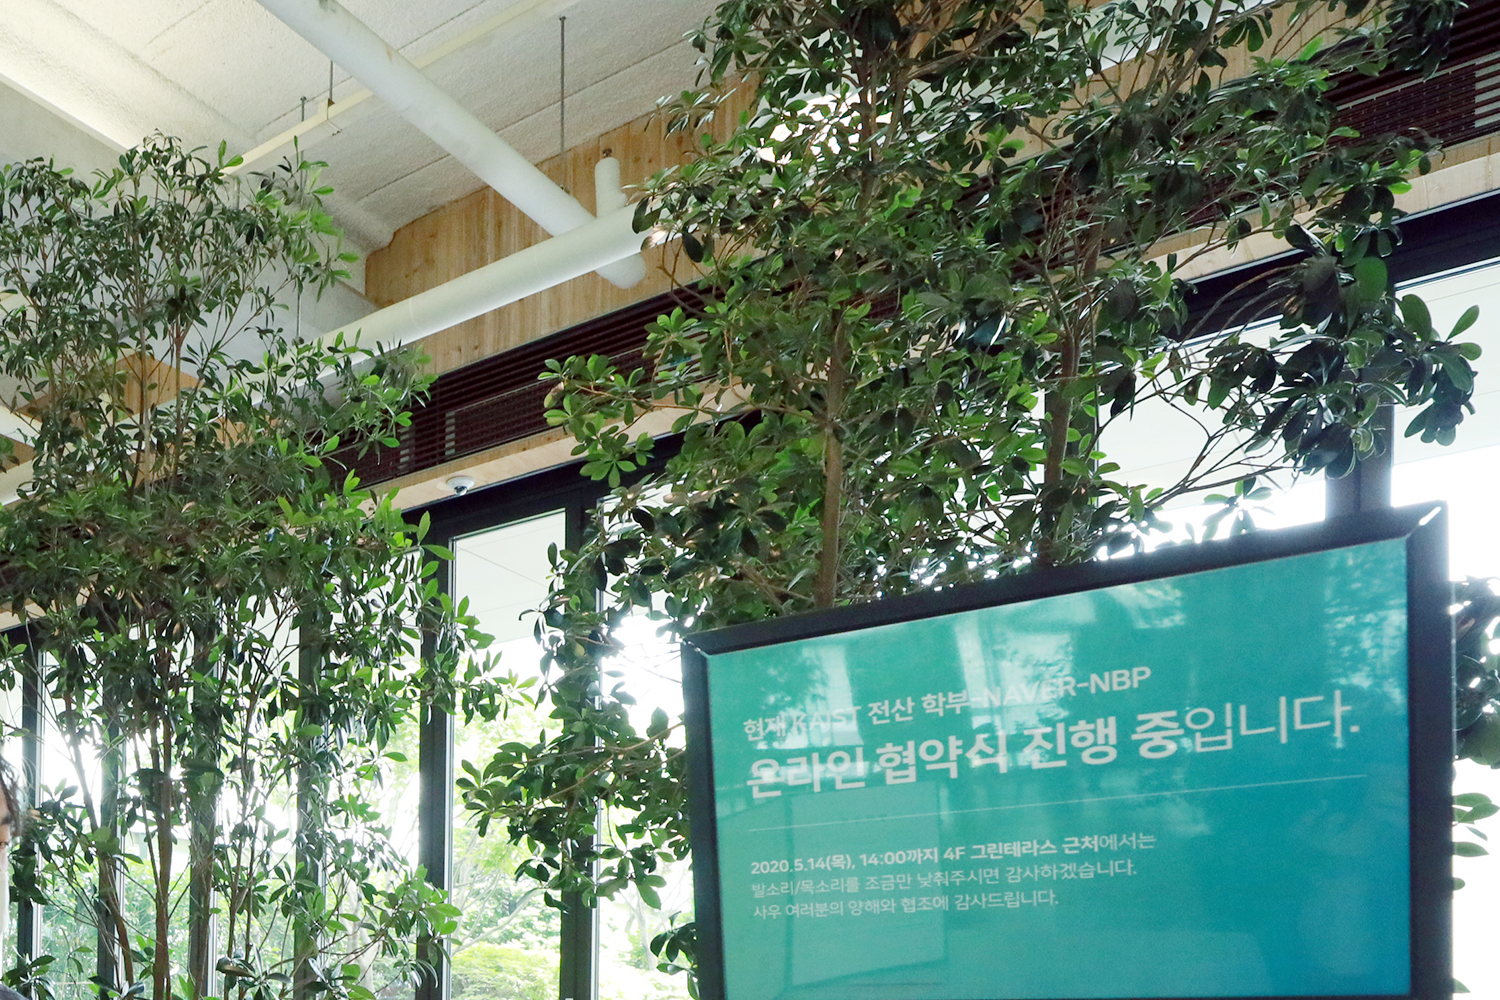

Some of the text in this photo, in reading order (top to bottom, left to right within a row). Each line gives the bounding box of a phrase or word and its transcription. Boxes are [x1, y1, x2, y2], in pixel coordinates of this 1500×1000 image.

[743, 714, 787, 741] 현재
[791, 706, 862, 736] KAIST
[867, 696, 915, 725] 전산
[746, 689, 1361, 799] 온라인 협약식 진행 중입니다.
[750, 832, 1157, 875] 2020.5.14(목), 14:00까지 4F 그린테라스 근처에서는
[751, 858, 1137, 899] 발소리/목소리를 조금만 낮춰주시면 감사하겠습니다.
[753, 889, 1059, 920] 사우 여러분의 양해와 협조에 감사드립니다.
